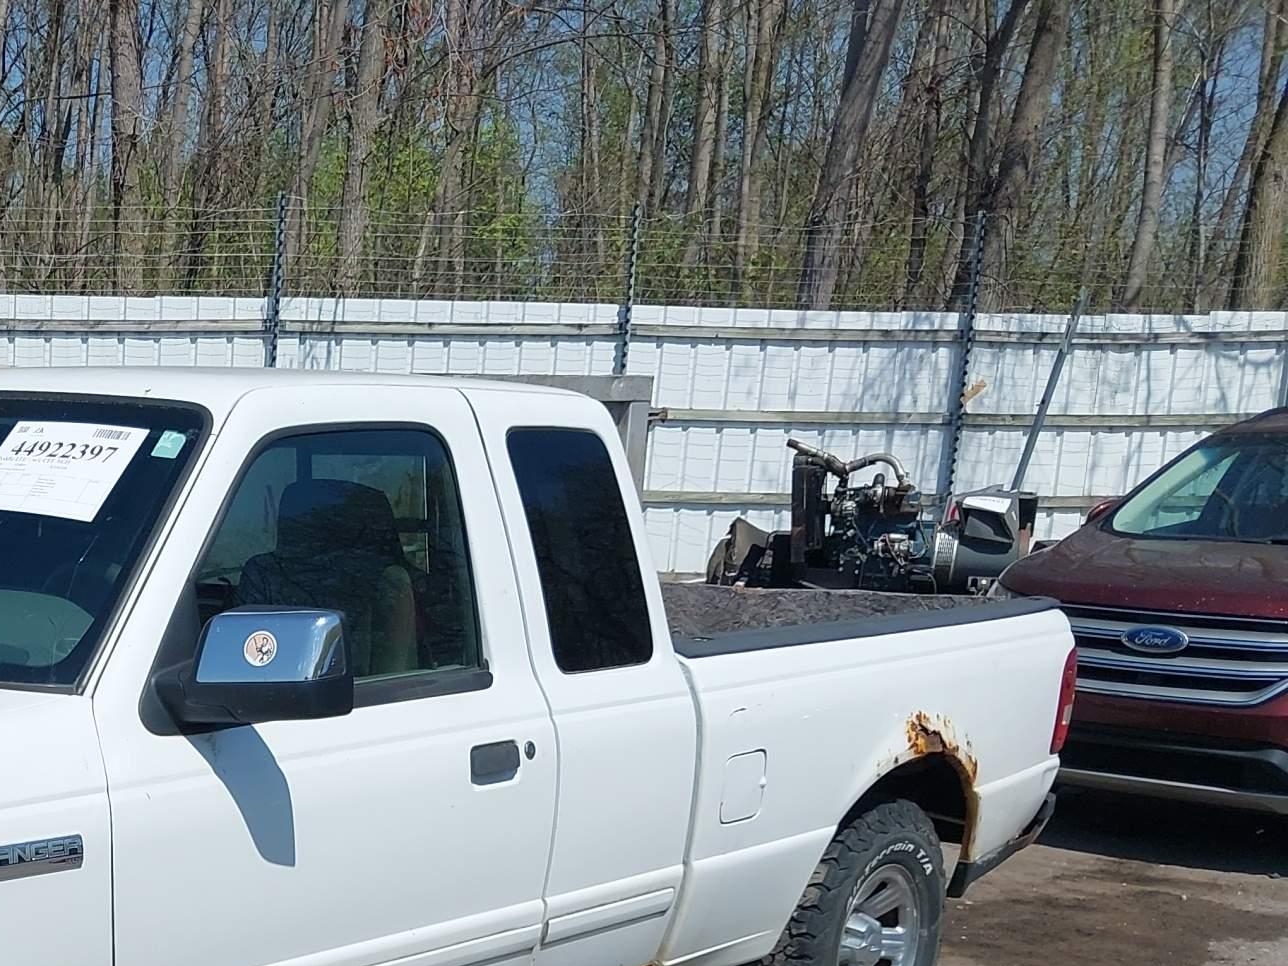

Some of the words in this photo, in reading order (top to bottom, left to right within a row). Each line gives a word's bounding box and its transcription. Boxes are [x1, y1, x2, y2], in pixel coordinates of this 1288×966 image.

[11, 440, 119, 464] 44922397
[1134, 631, 1172, 646] Ford
[916, 848, 933, 876] T/A
